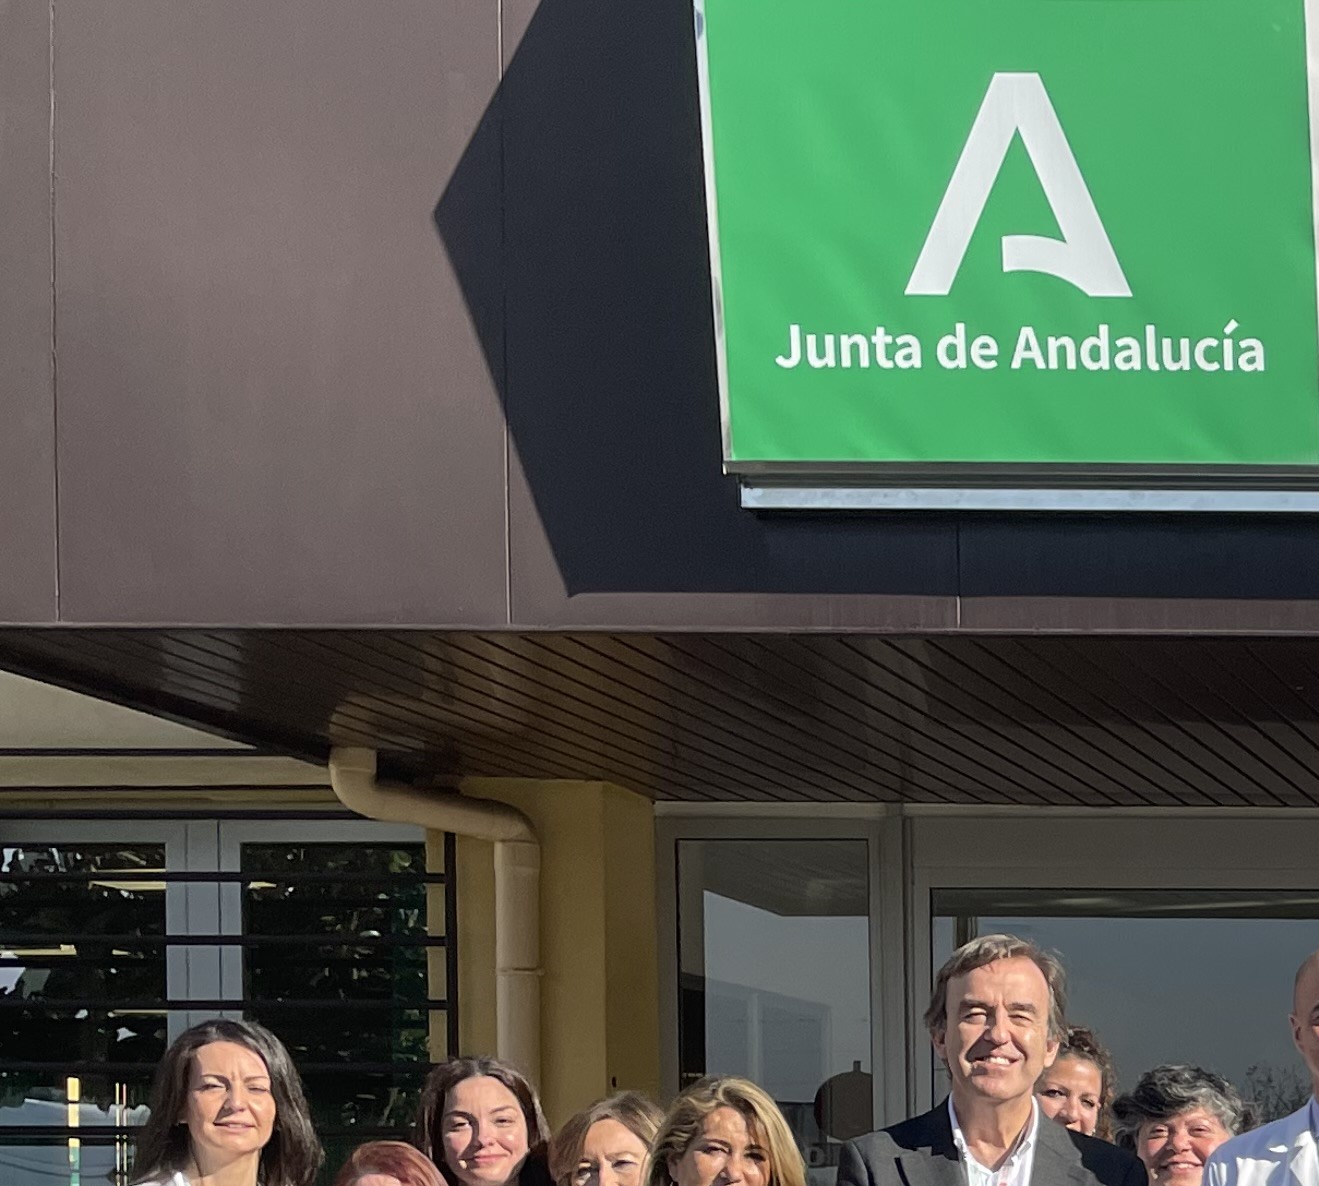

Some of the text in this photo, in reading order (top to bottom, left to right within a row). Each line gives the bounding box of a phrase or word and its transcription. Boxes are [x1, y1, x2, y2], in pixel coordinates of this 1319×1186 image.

[776, 319, 1265, 372] Junta de Andalucía
